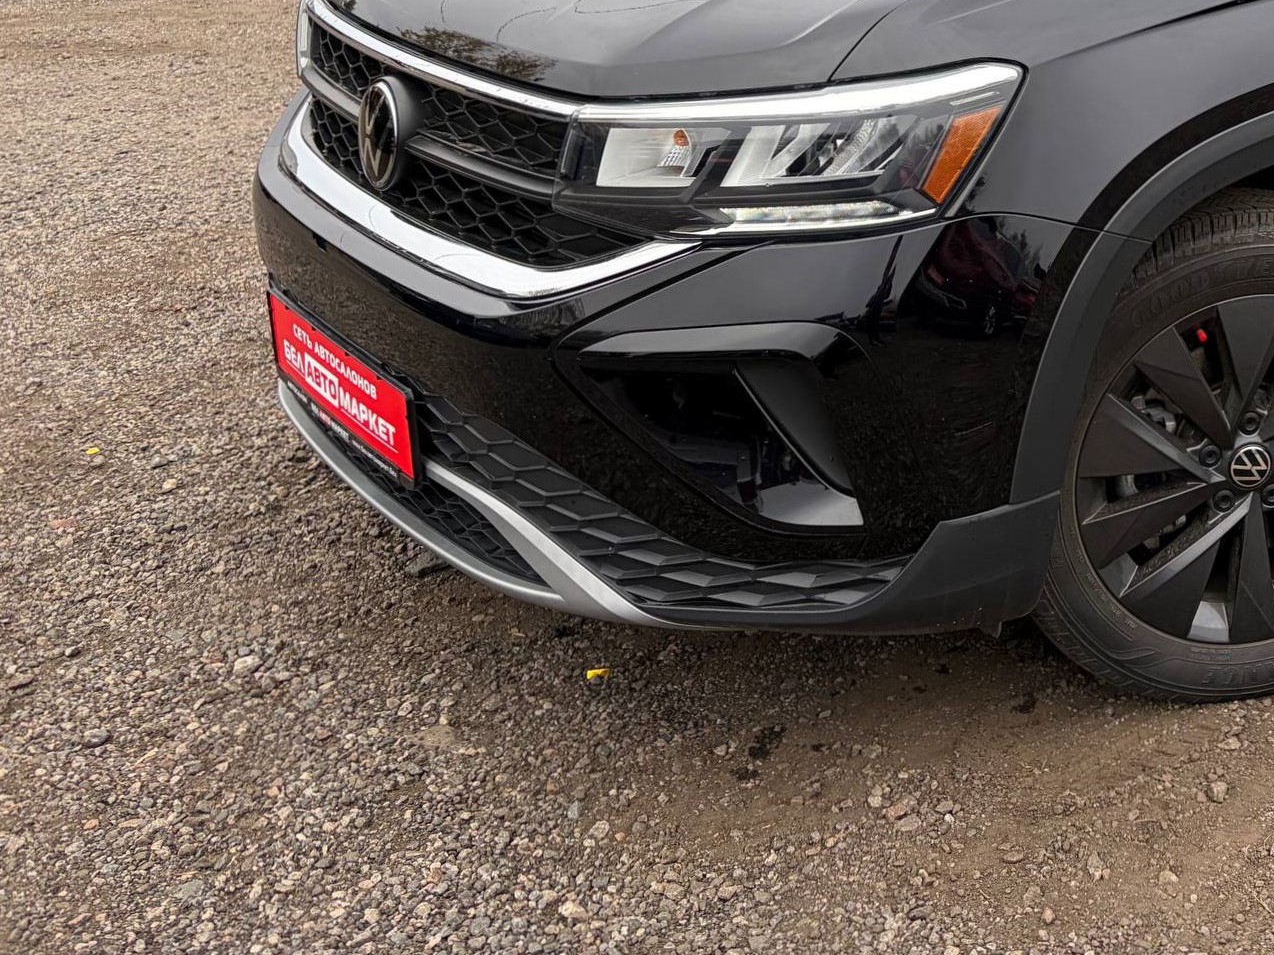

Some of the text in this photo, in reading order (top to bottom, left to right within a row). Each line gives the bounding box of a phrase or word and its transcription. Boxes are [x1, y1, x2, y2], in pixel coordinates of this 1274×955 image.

[284, 339, 305, 374] БЕЛ
[307, 359, 338, 402] АВТО
[340, 386, 396, 446] МАРКЕТ
[293, 324, 312, 350] СЕТЬ
[314, 342, 377, 400] АВТОСАЛОНОВ
